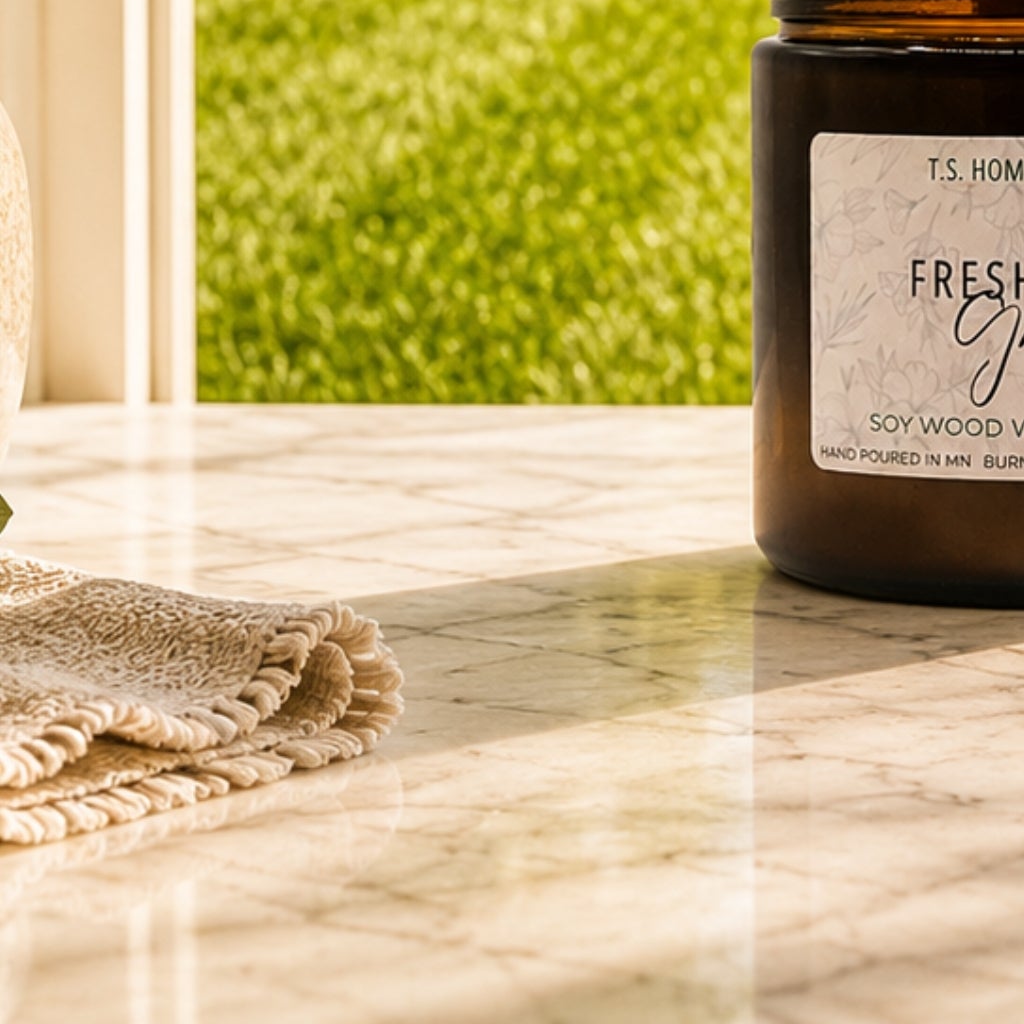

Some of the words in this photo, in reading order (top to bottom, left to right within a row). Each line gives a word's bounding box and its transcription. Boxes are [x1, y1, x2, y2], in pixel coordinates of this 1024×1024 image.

[869, 413, 914, 434] SOY
[919, 416, 1003, 438] WOOD
[820, 445, 857, 461] HAND
[859, 448, 921, 466] POURED
[925, 453, 941, 466] IN
[945, 454, 972, 468] MN
